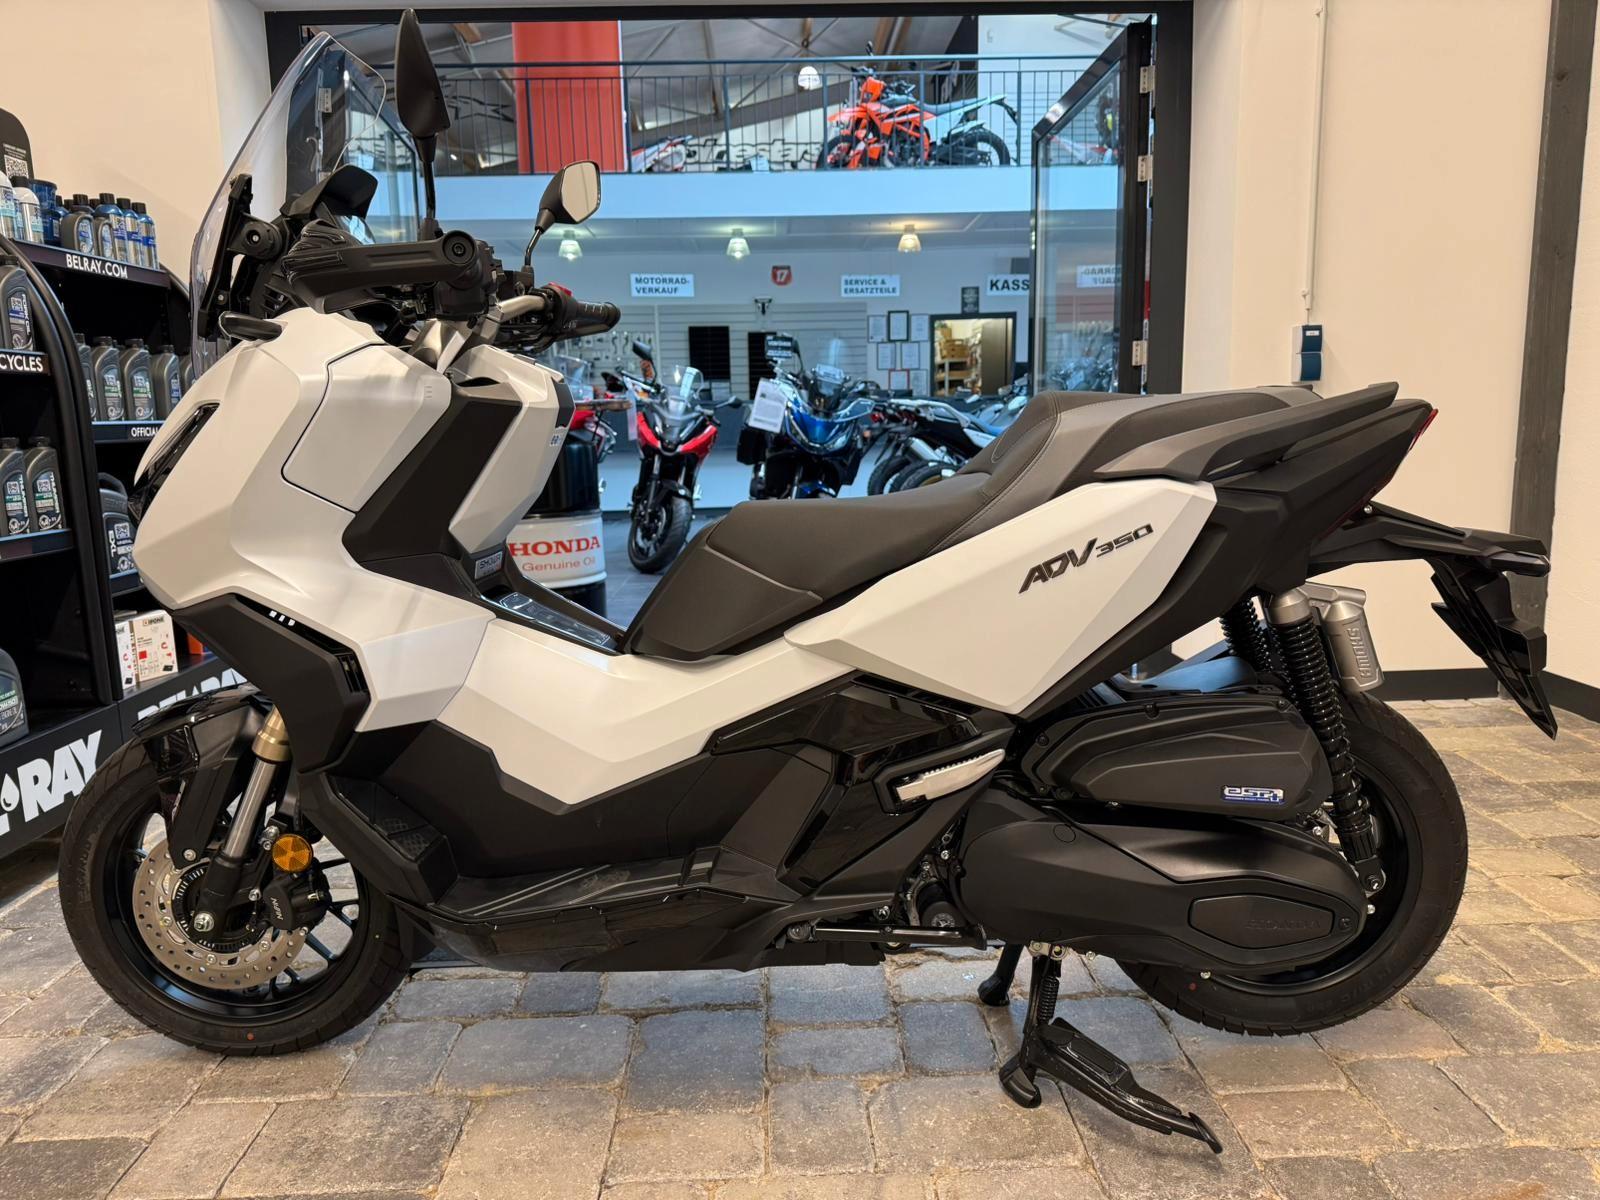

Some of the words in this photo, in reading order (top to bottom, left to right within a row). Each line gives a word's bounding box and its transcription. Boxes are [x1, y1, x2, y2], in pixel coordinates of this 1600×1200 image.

[65, 254, 128, 279] BELRAY.COM
[635, 277, 690, 285] MOTORRAD-
[844, 287, 896, 295] ERSATZTEILE
[0, 354, 43, 372] CYCLES
[508, 536, 600, 557] HONDA
[522, 559, 581, 572] Genuine
